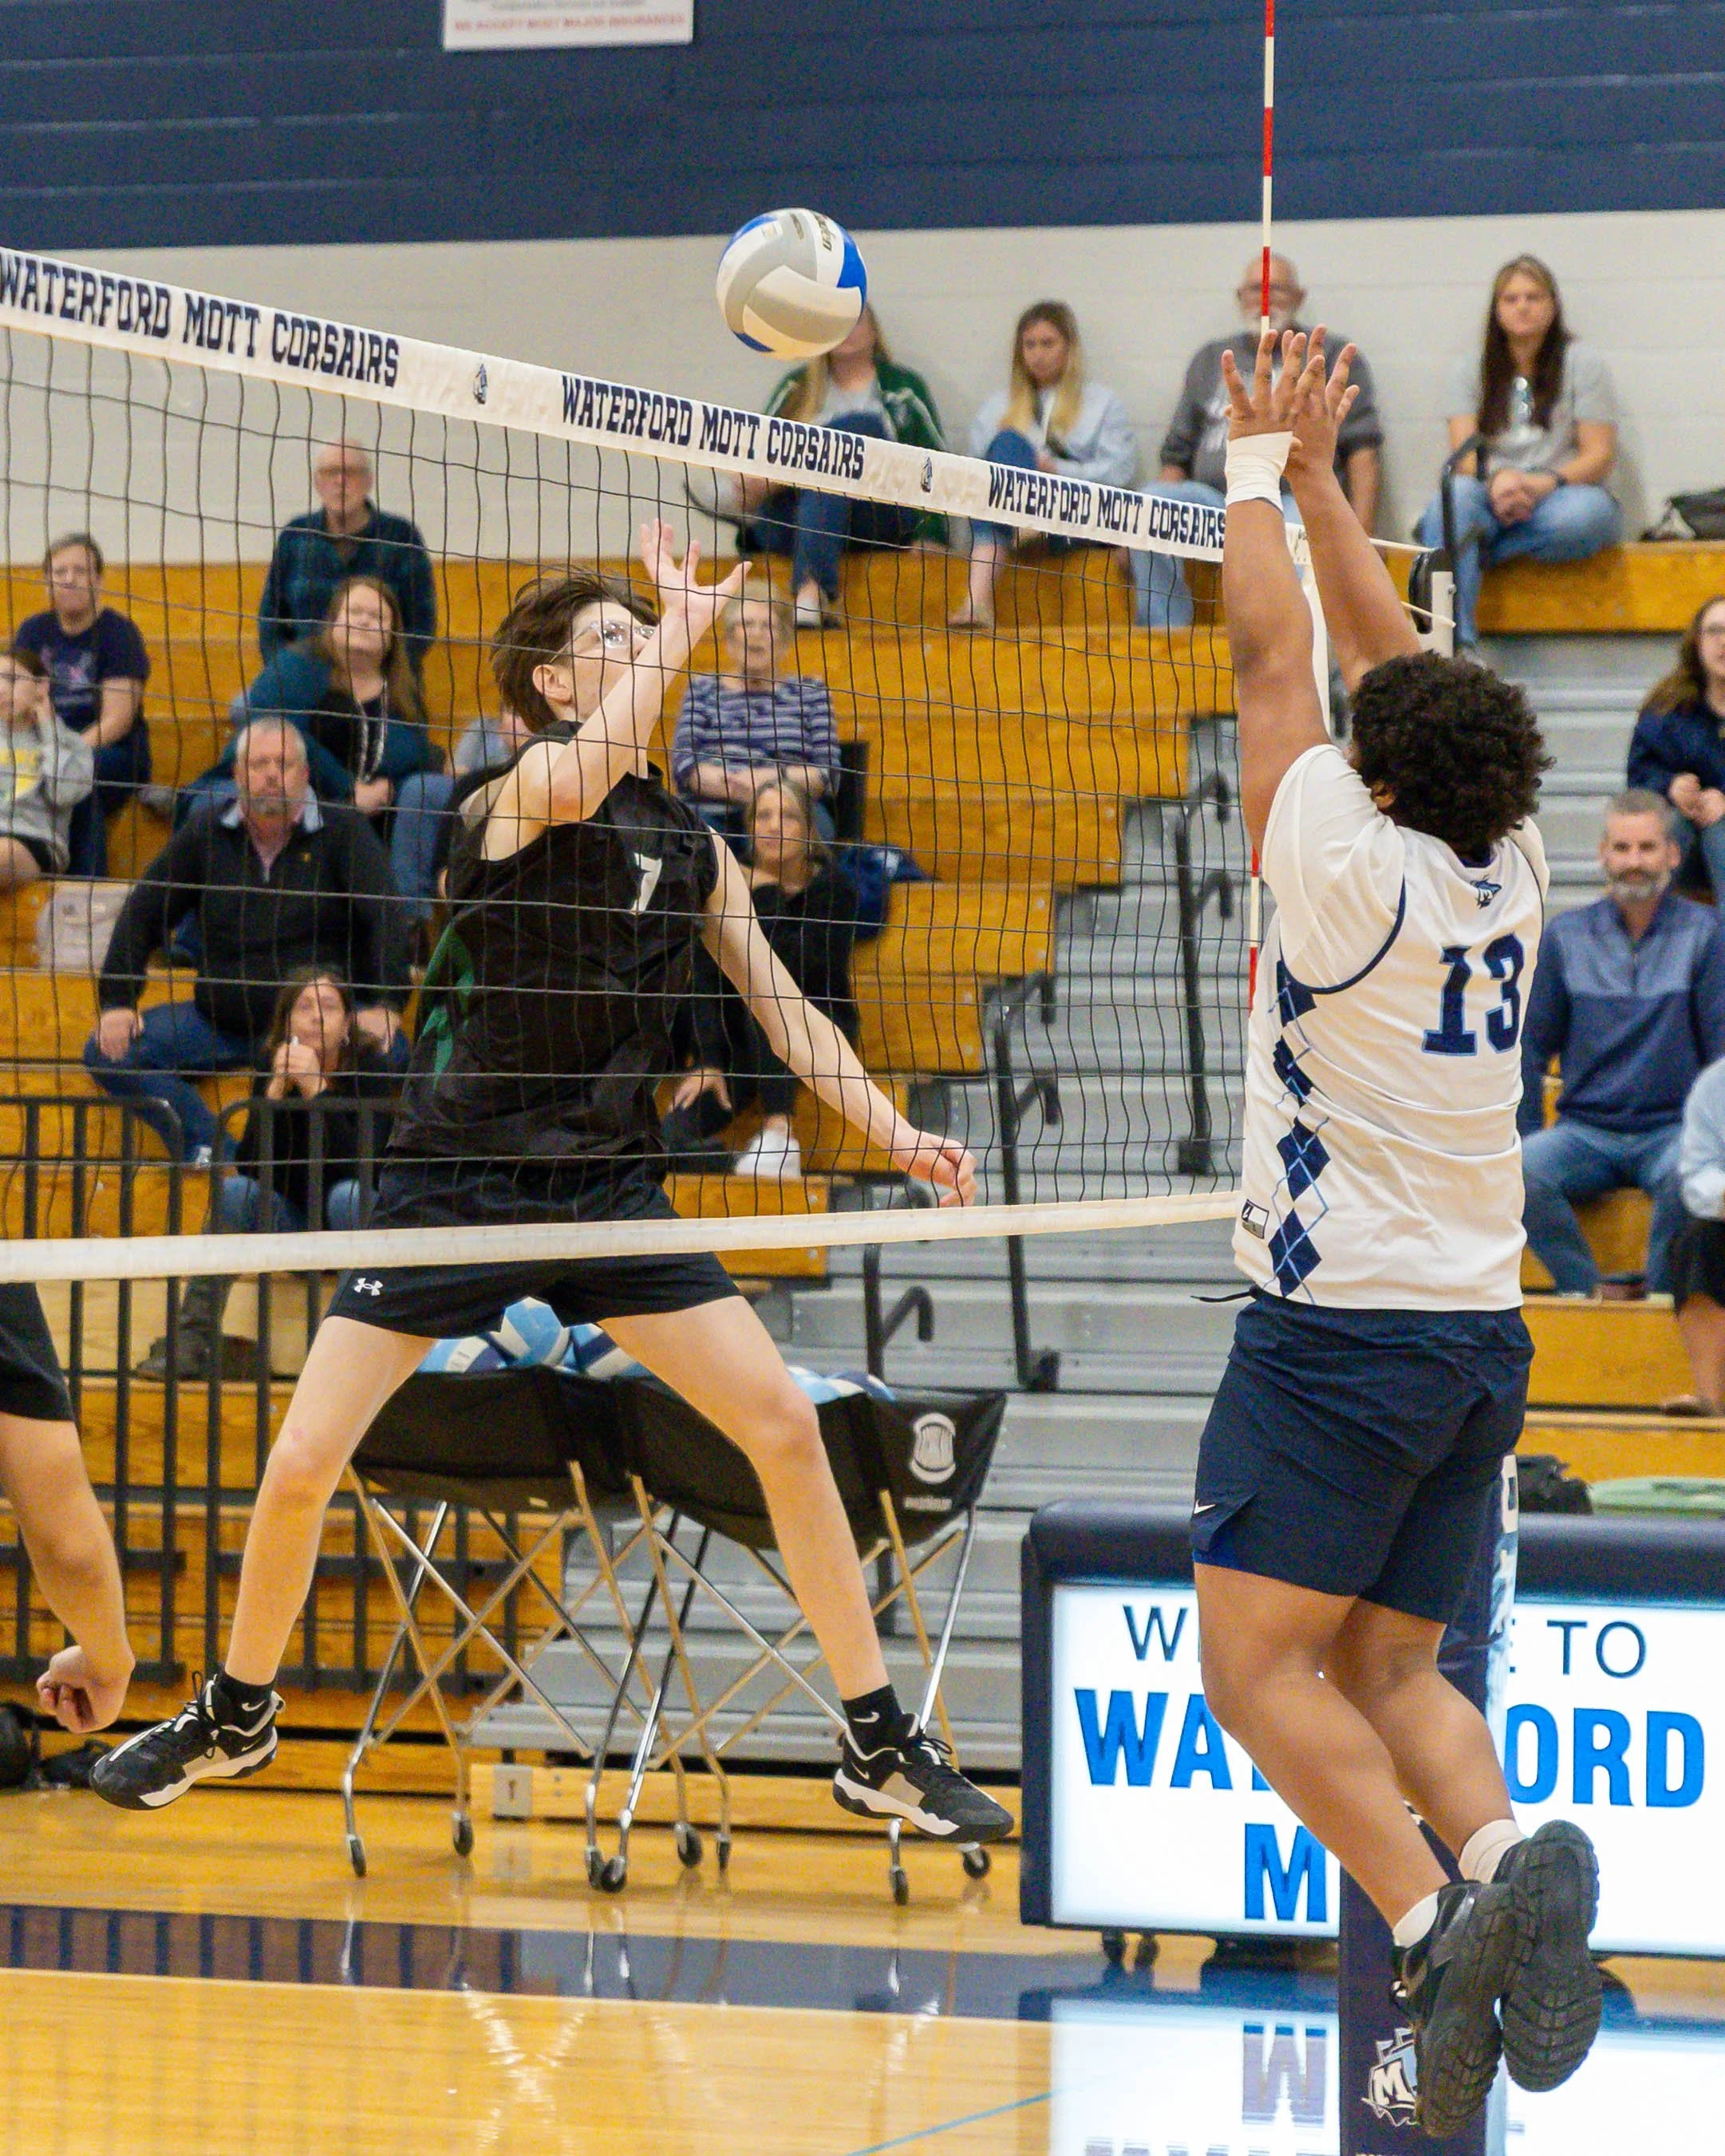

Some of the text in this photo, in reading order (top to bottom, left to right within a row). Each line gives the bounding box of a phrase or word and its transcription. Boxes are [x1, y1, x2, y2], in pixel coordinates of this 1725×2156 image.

[0, 253, 399, 389] WATERFORD MOTT CORSAIRS
[562, 375, 865, 480] WATERFORD MOTT CORSAIRS
[989, 464, 1226, 549] WATERFORD MOTT CORSAIRS
[629, 851, 662, 916] 7
[1421, 931, 1525, 1056] 13
[1545, 1619, 1648, 1680] TO
[1073, 1687, 1706, 1808] WAORD
